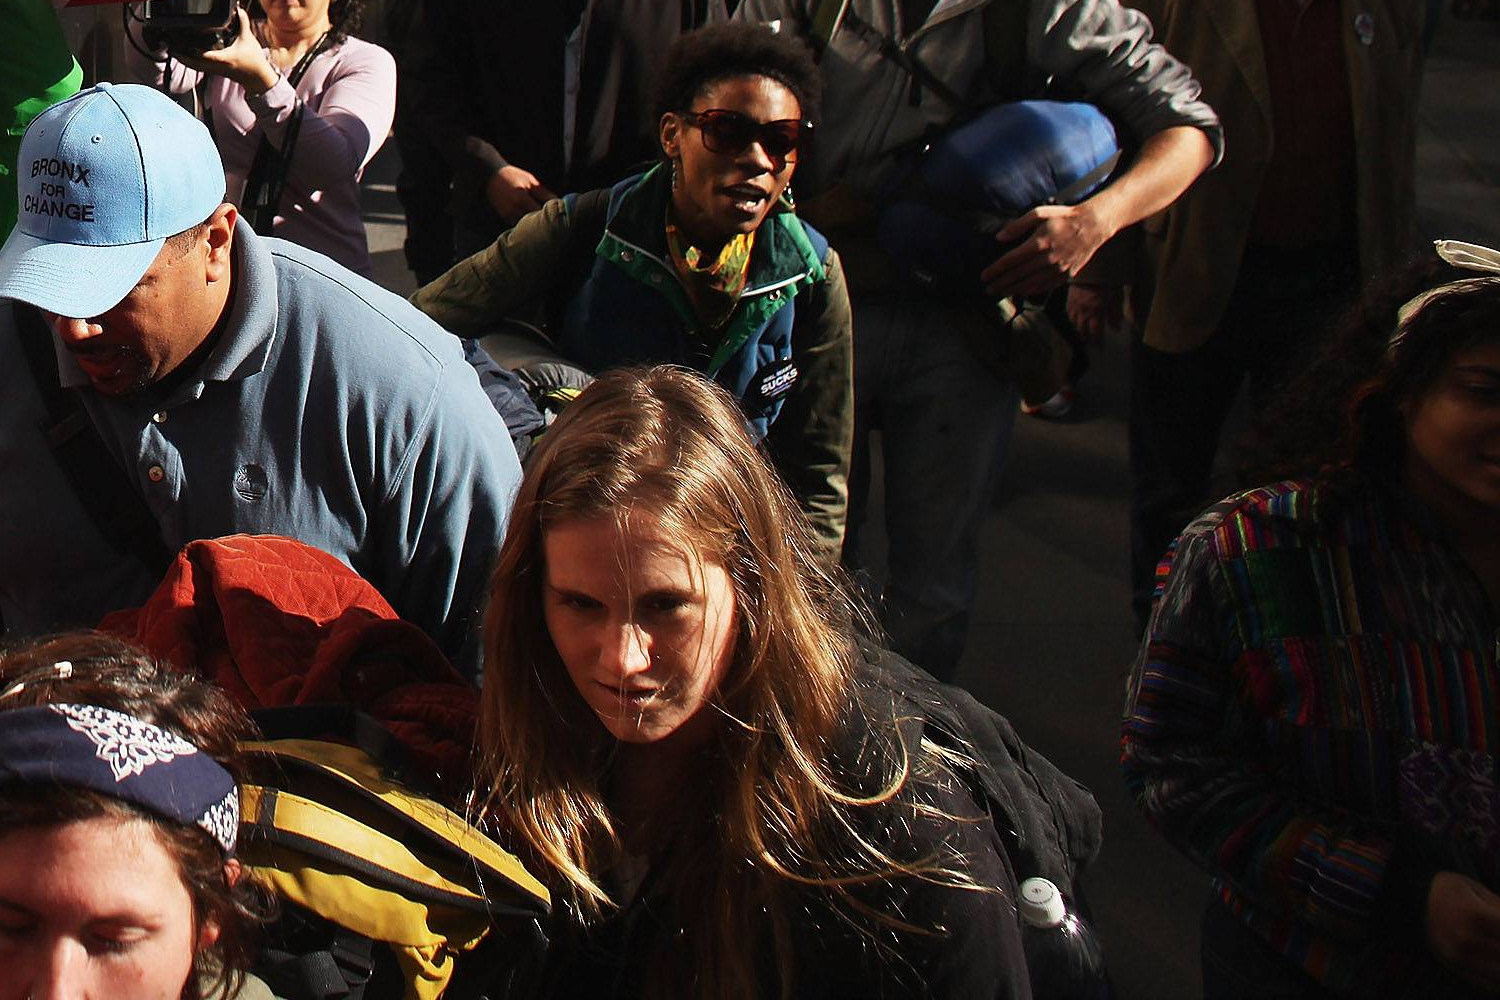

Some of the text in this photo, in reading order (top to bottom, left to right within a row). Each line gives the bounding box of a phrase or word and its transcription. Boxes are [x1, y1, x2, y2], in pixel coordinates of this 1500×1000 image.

[31, 158, 90, 187] BRONX
[41, 182, 66, 199] FOR
[24, 194, 95, 222] CHANGE
[760, 367, 799, 394] SUCKS
